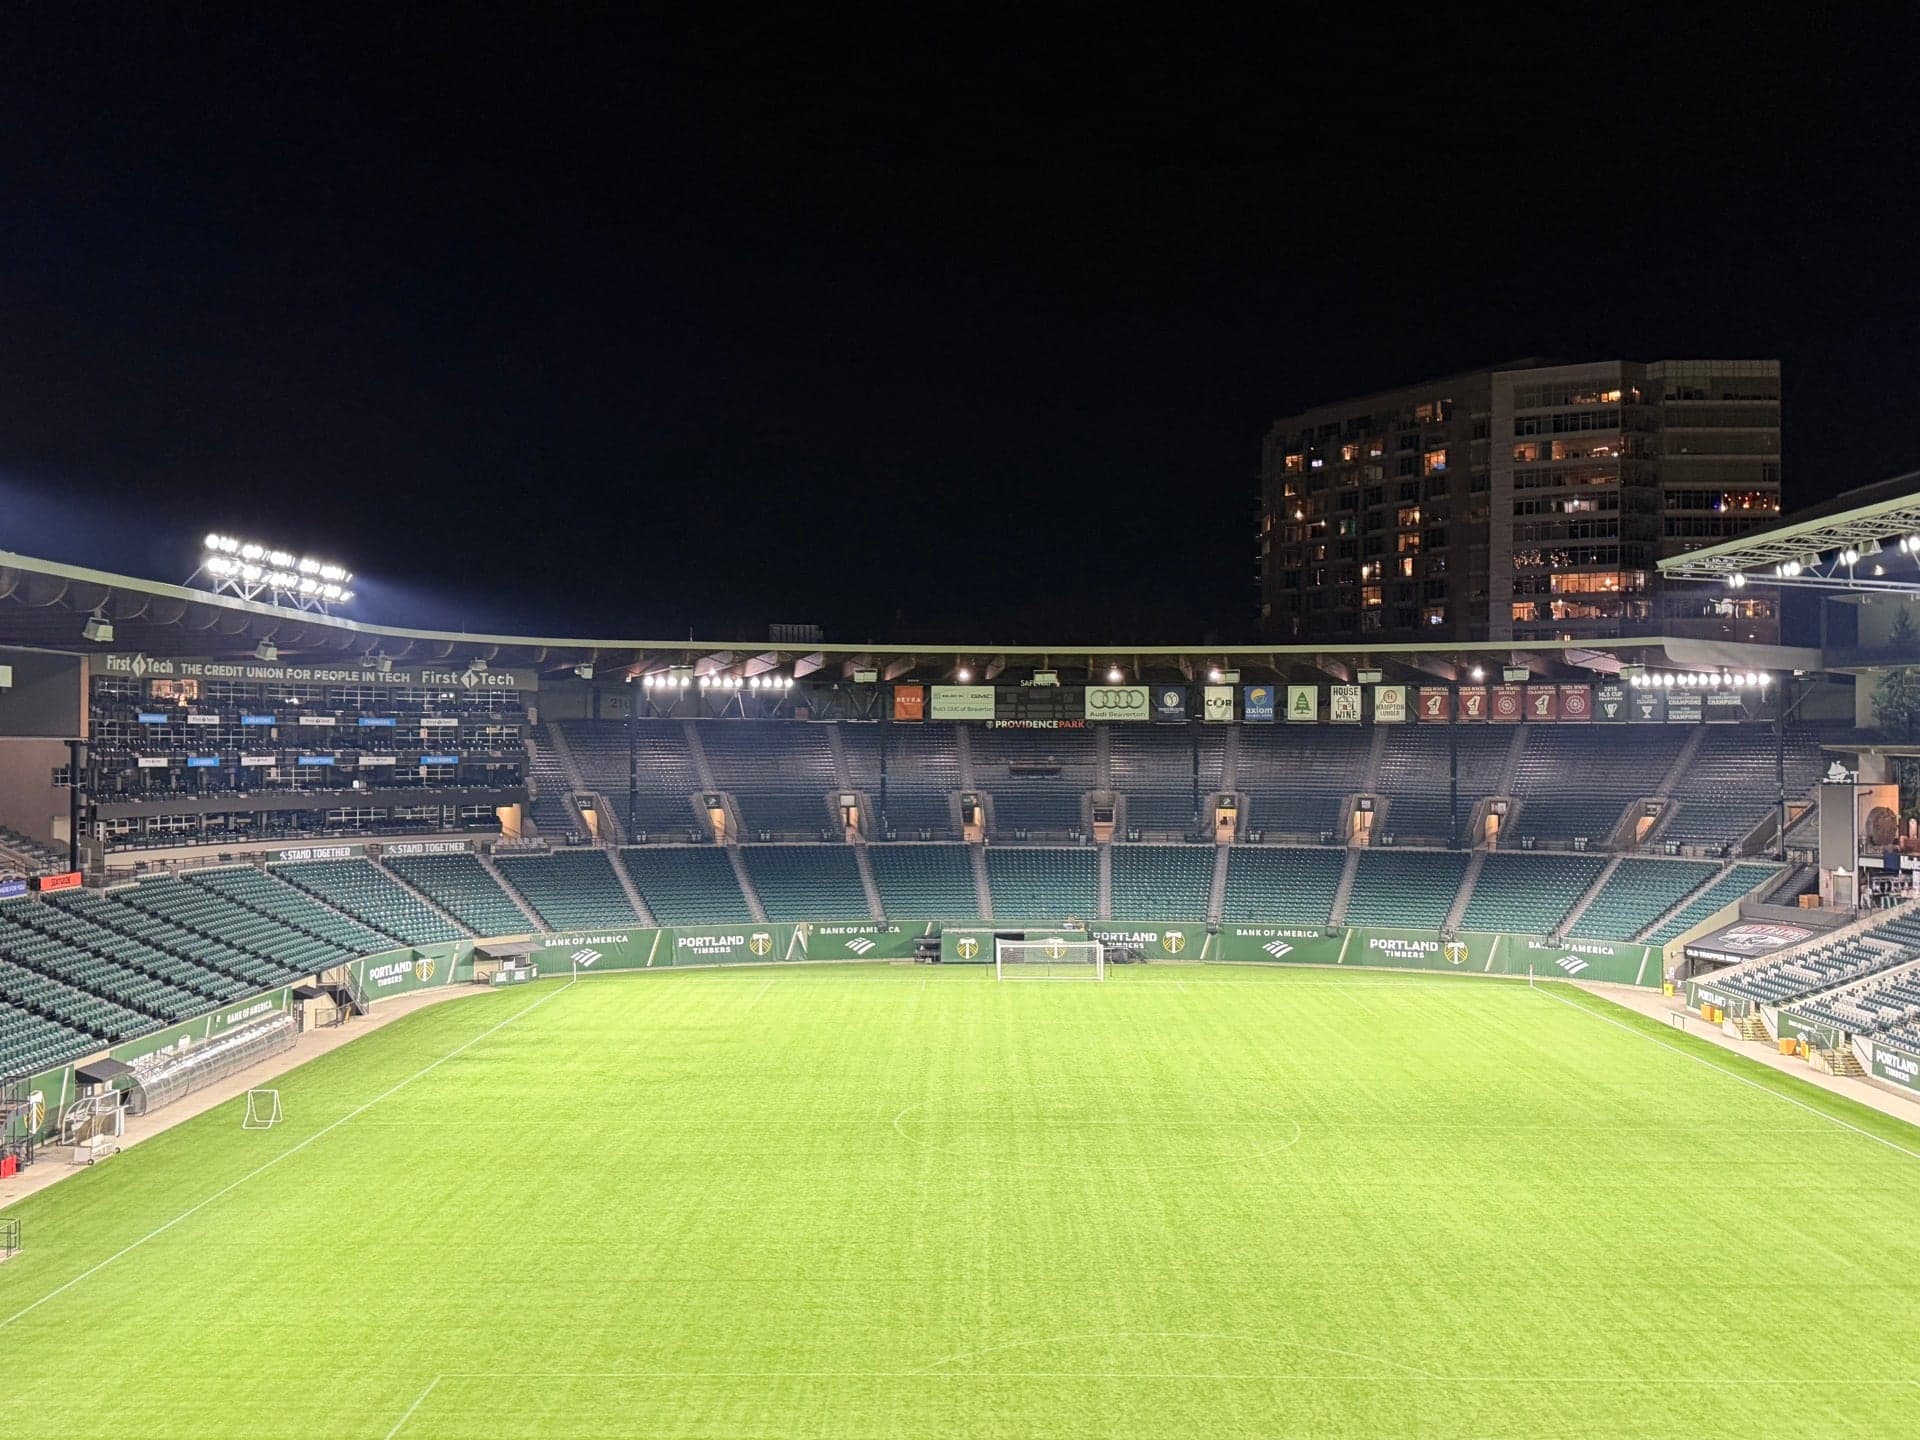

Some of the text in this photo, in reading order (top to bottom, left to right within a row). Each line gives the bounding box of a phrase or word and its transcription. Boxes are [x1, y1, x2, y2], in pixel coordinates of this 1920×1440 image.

[107, 655, 173, 674] First Tech
[181, 664, 410, 683] THE CREDIT UNION FOR PEOPLE IN TECH
[422, 671, 514, 686] First Tech
[1333, 687, 1358, 696] HOUSE
[1246, 706, 1272, 714] axiom
[1335, 711, 1357, 719] WINE
[287, 847, 350, 860] STAND TOGETHER
[397, 842, 465, 854] STAND TOGETHER
[820, 927, 845, 935] BANK
[859, 926, 900, 934] AMECA
[1236, 928, 1319, 938] BANK OF AMERICA
[545, 935, 628, 947] BANK OF AMERICA
[679, 935, 744, 948] PORTLAND
[1370, 938, 1438, 951] PORTLAND
[693, 946, 731, 954] TIMBERS
[1571, 944, 1614, 955] AMERICA
[369, 961, 411, 981] PORTLAND
[249, 1000, 273, 1016] AMERICA
[1876, 1049, 1918, 1075] PORTLAND
